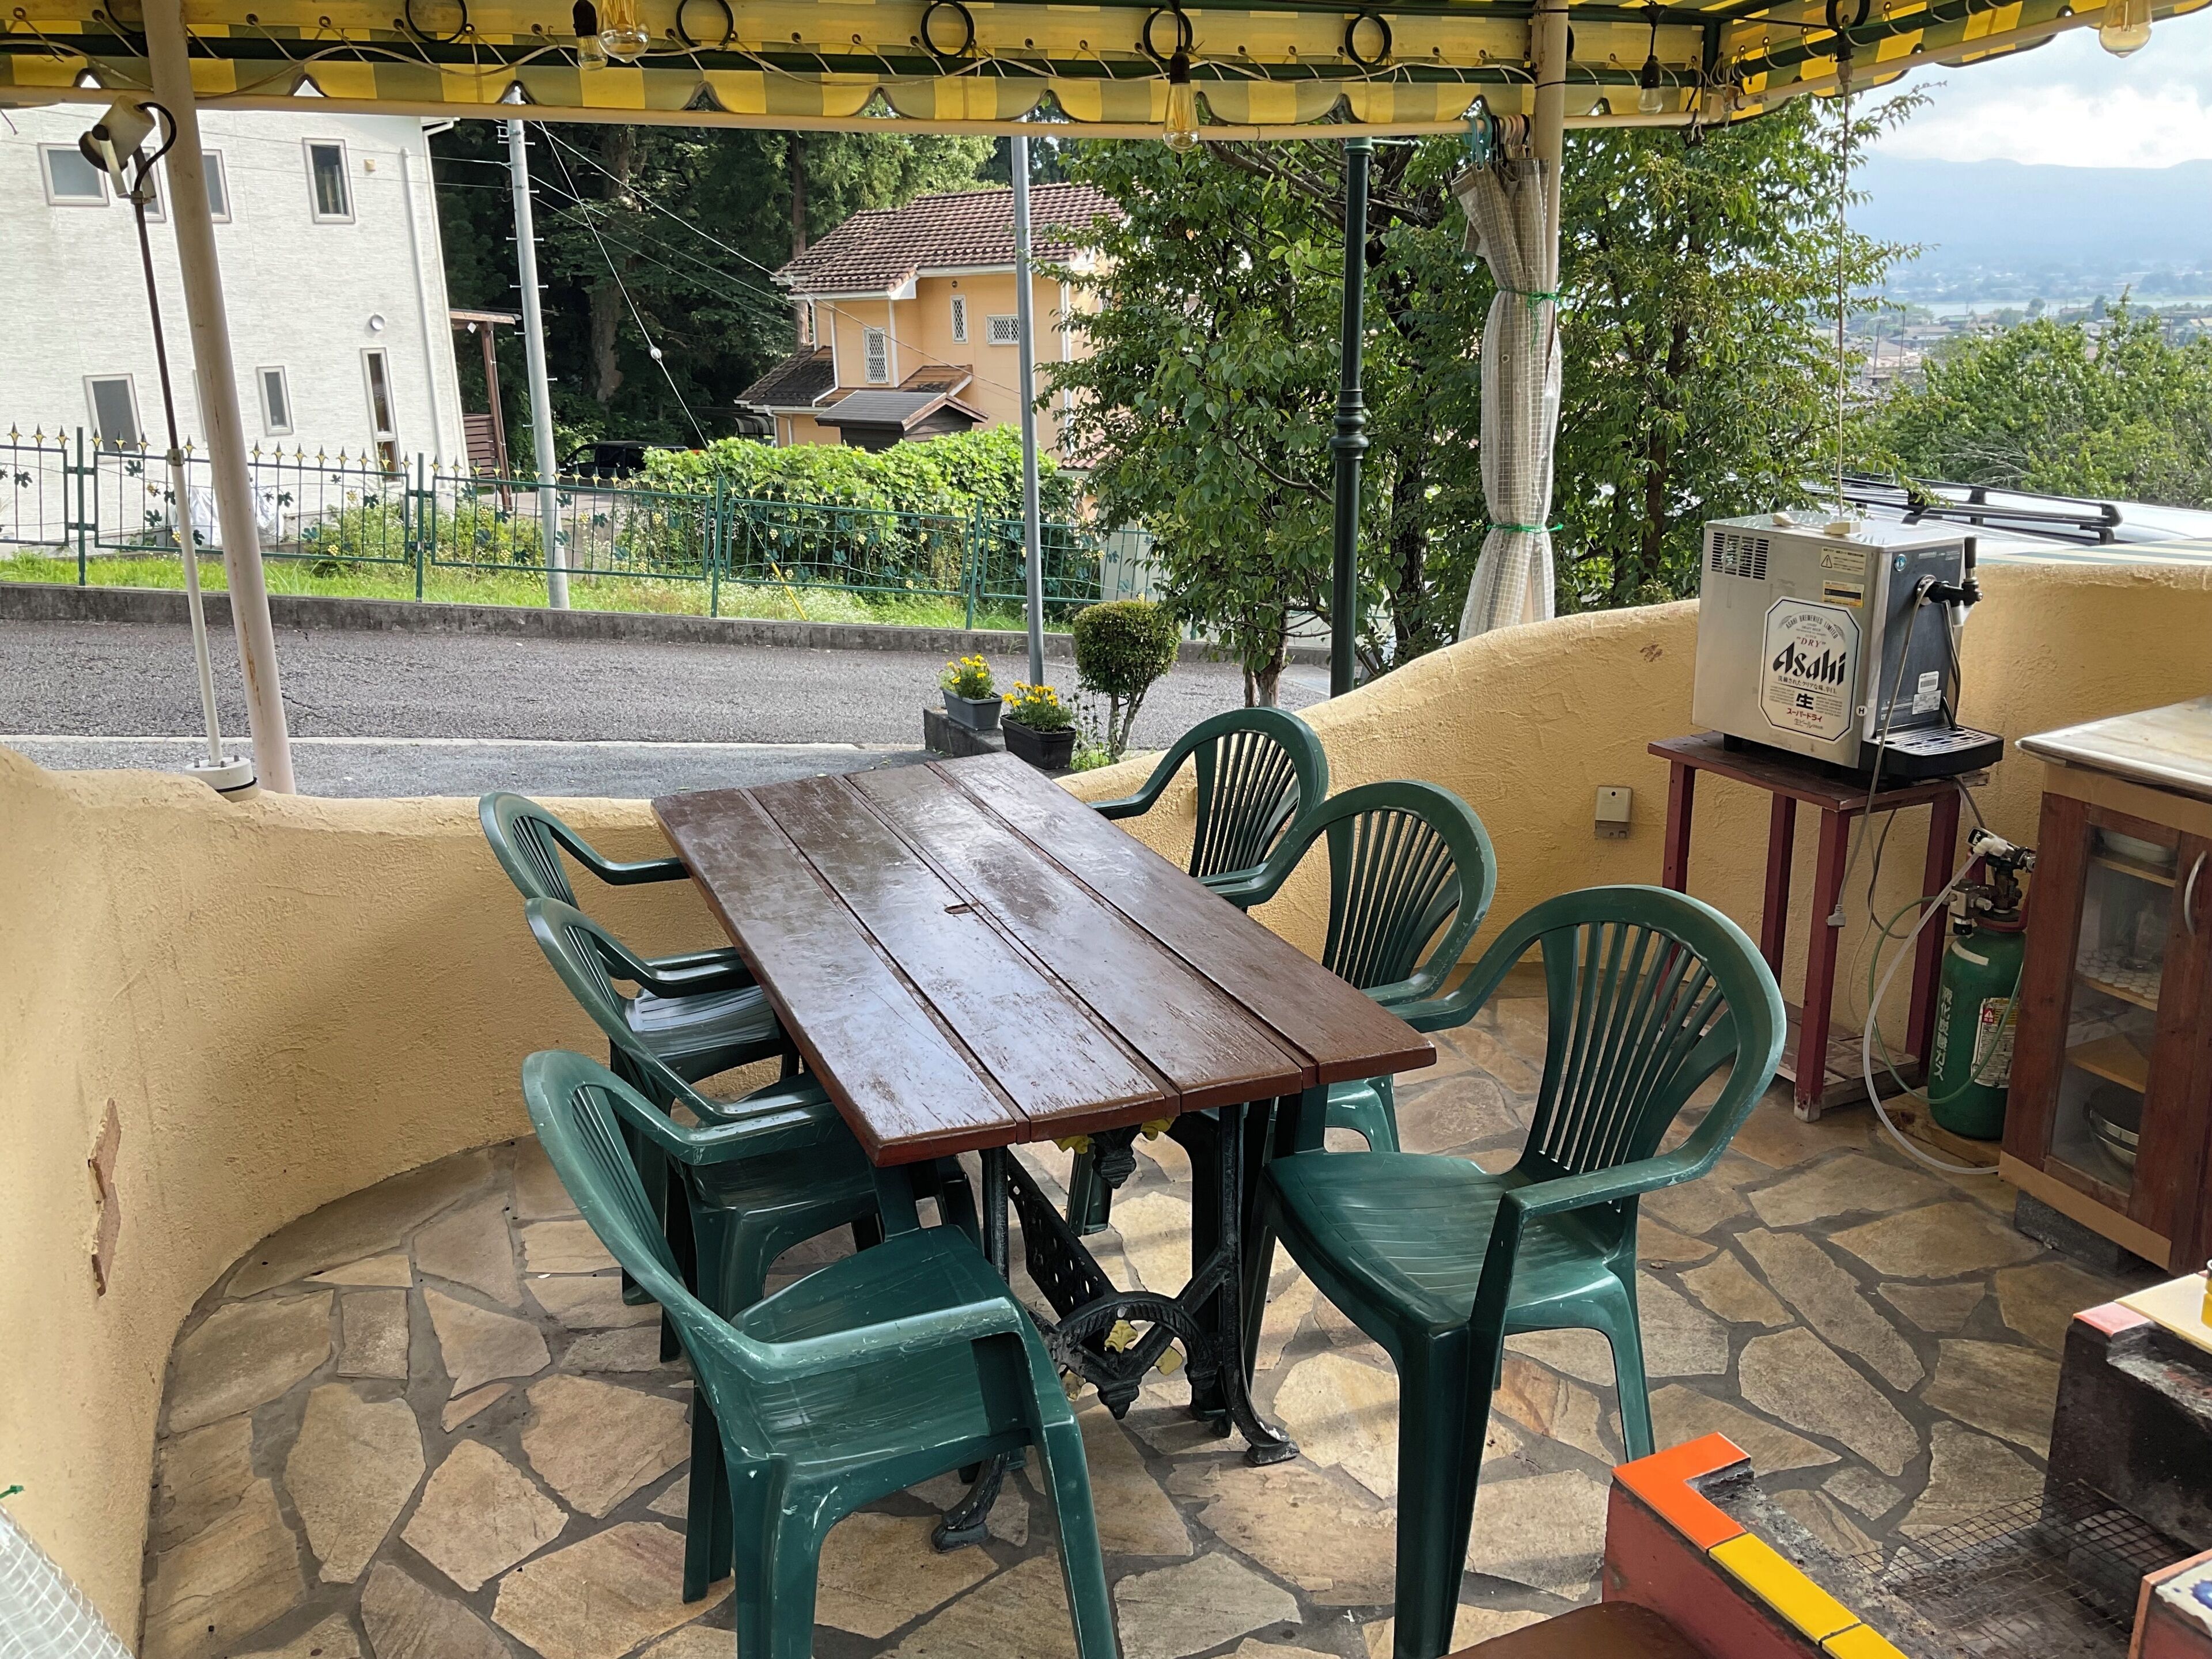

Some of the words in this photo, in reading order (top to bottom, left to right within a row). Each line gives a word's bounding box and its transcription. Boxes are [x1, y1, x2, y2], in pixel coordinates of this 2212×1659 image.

[1785, 618, 1798, 629] ASAHI
[1799, 615, 1824, 624] BREWERIES
[1824, 621, 1839, 639] LIMITED
[1773, 642, 1846, 685] Asahi
[1796, 693, 1814, 710] 生
[1786, 708, 1823, 722] スーパードライ
